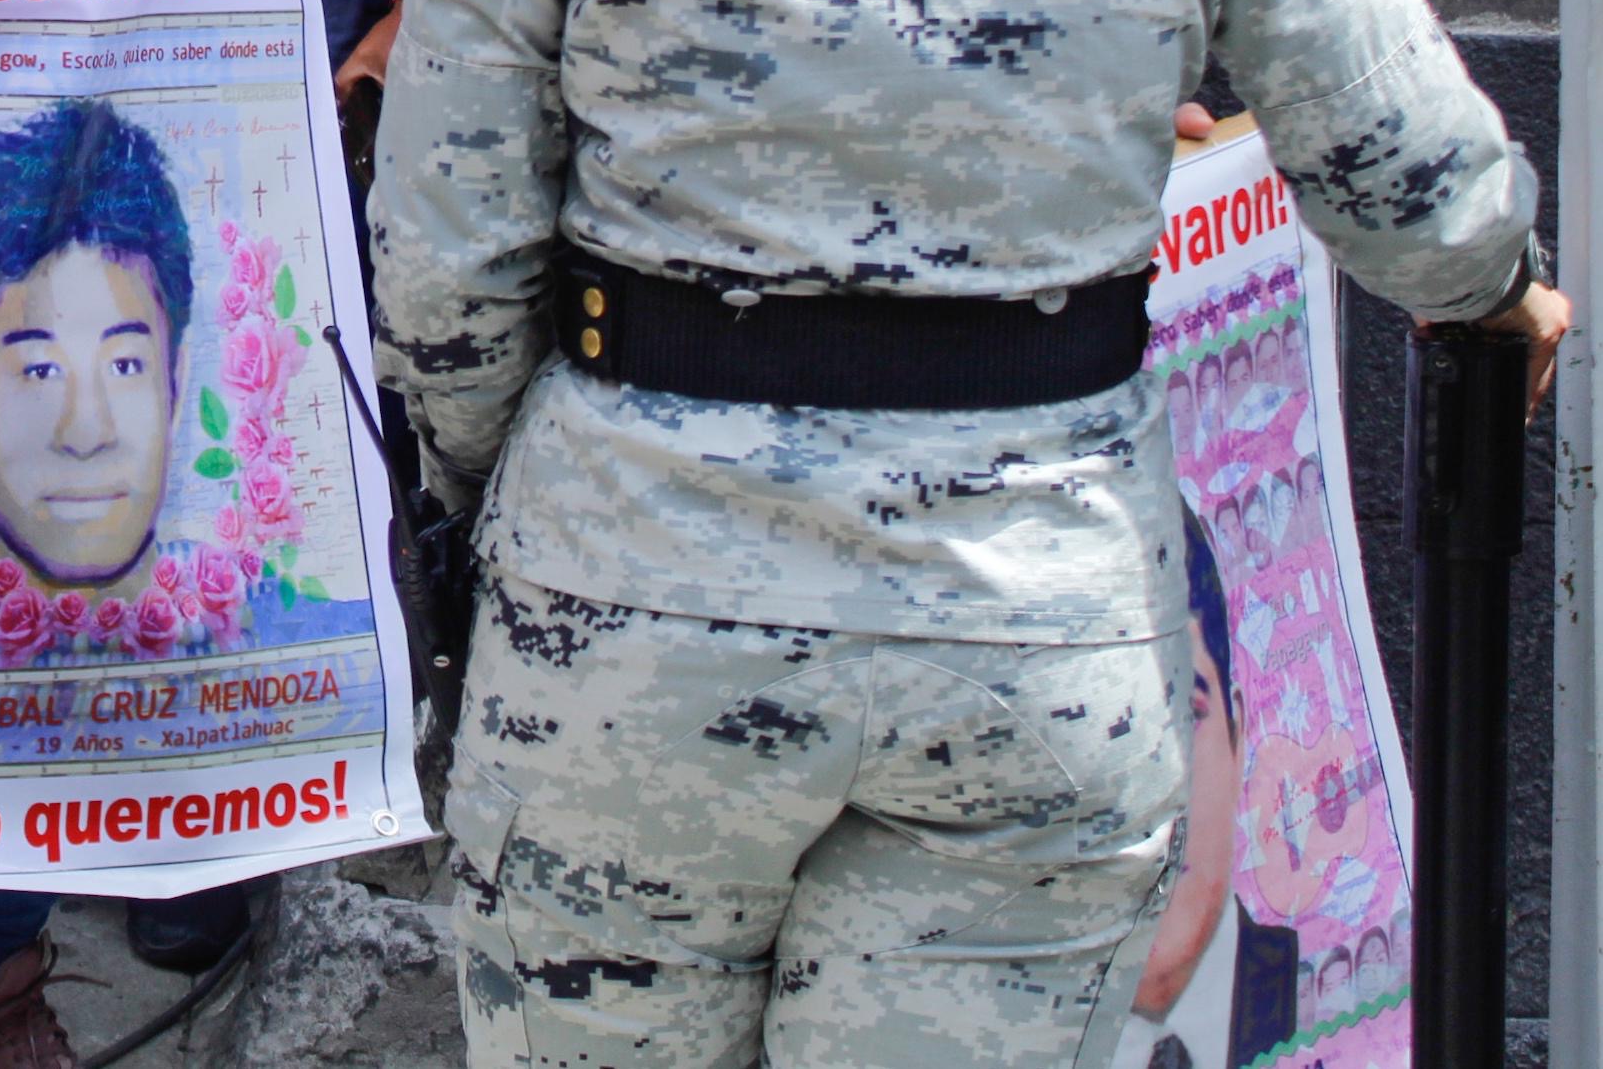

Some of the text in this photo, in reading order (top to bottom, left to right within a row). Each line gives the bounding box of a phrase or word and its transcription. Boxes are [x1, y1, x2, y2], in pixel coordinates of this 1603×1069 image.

[62, 50, 118, 70] Escocia,
[123, 45, 165, 68] quiero
[172, 42, 213, 61] saber
[220, 40, 259, 59] dónde
[265, 38, 295, 58] está
[90, 687, 179, 724] CRUZ
[199, 668, 341, 715] MENDOZA
[35, 735, 62, 755] 19
[72, 734, 124, 753] Años
[161, 717, 295, 749] Xalpatlahuac
[23, 760, 350, 863] queremos!
